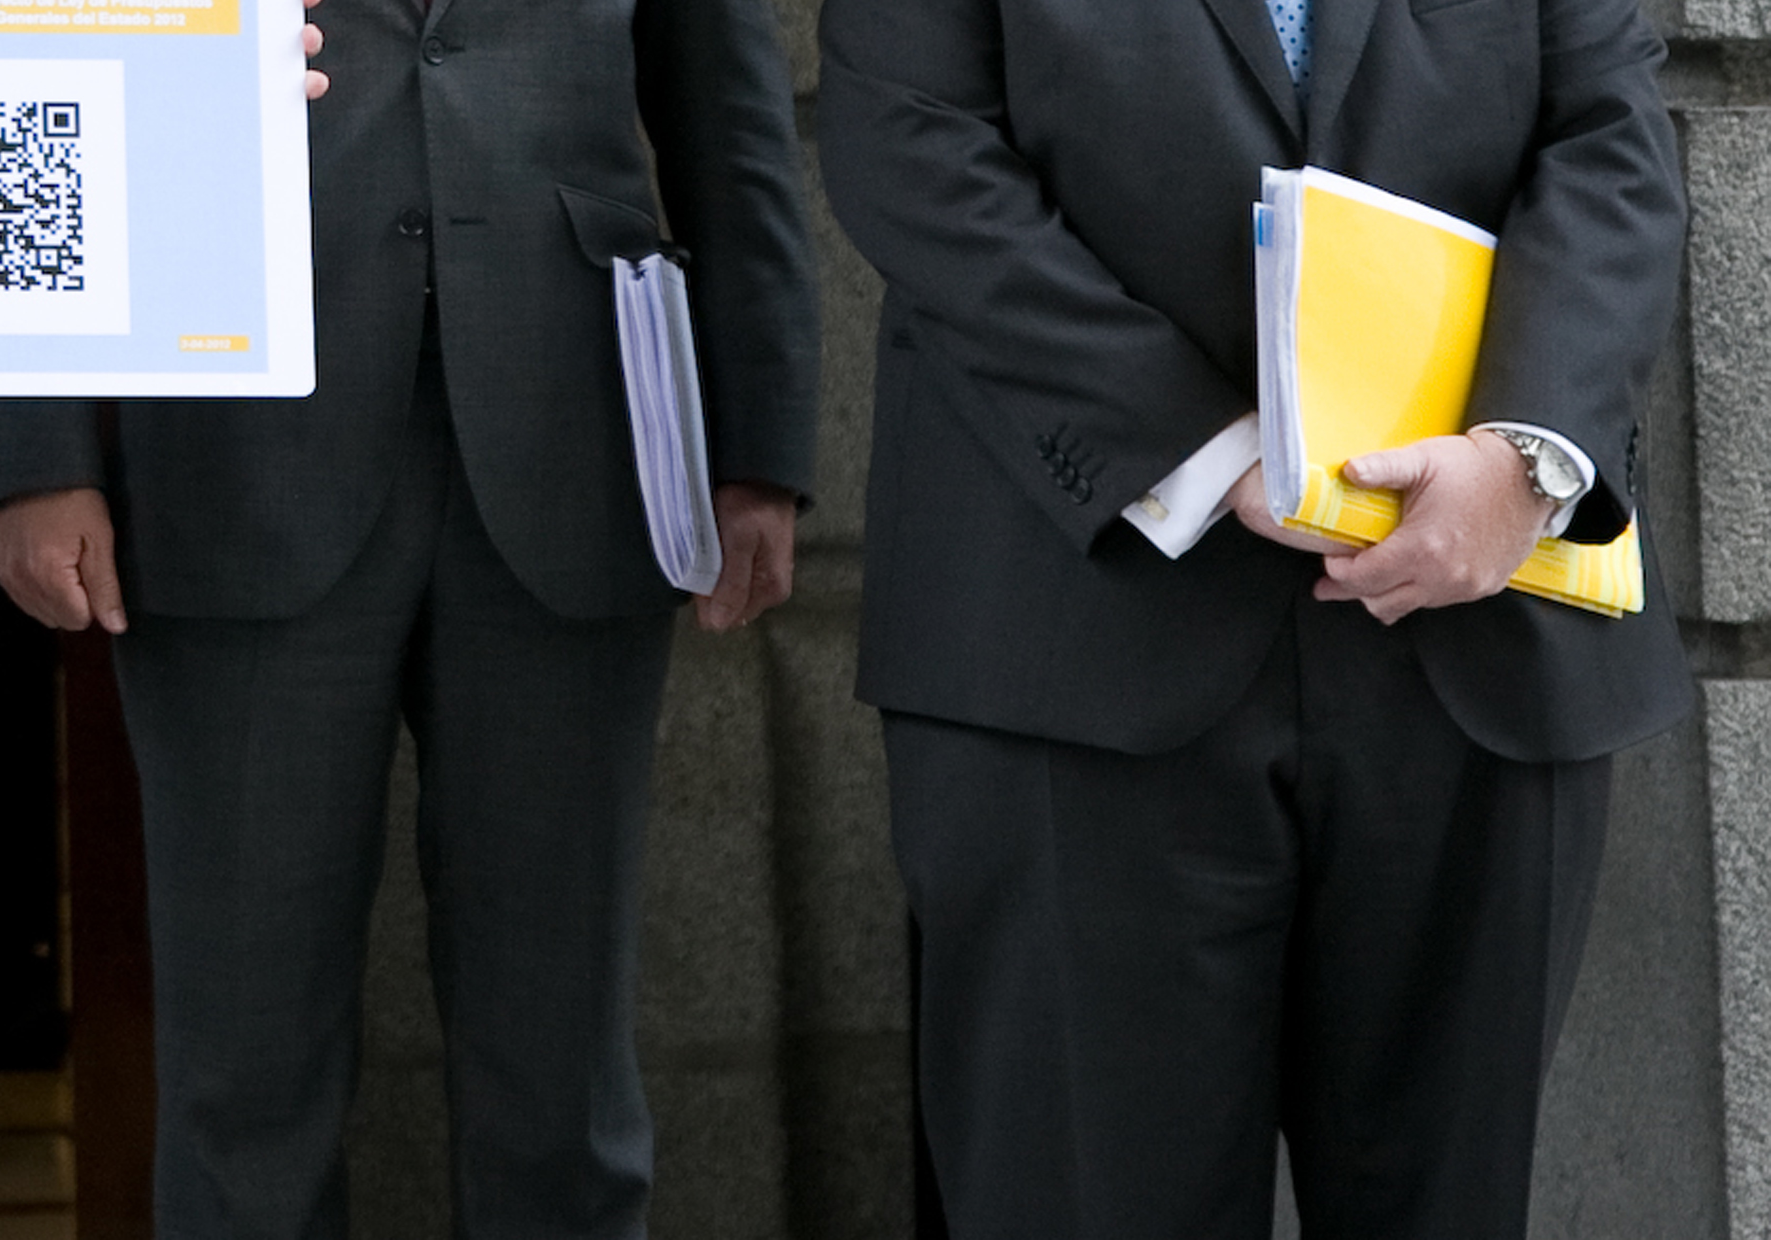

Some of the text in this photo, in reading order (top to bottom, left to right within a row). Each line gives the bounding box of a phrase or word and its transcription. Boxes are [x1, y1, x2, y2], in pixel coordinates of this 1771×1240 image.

[72, 11, 96, 25] del
[98, 12, 151, 26] Estado
[154, 13, 186, 27] 2012
